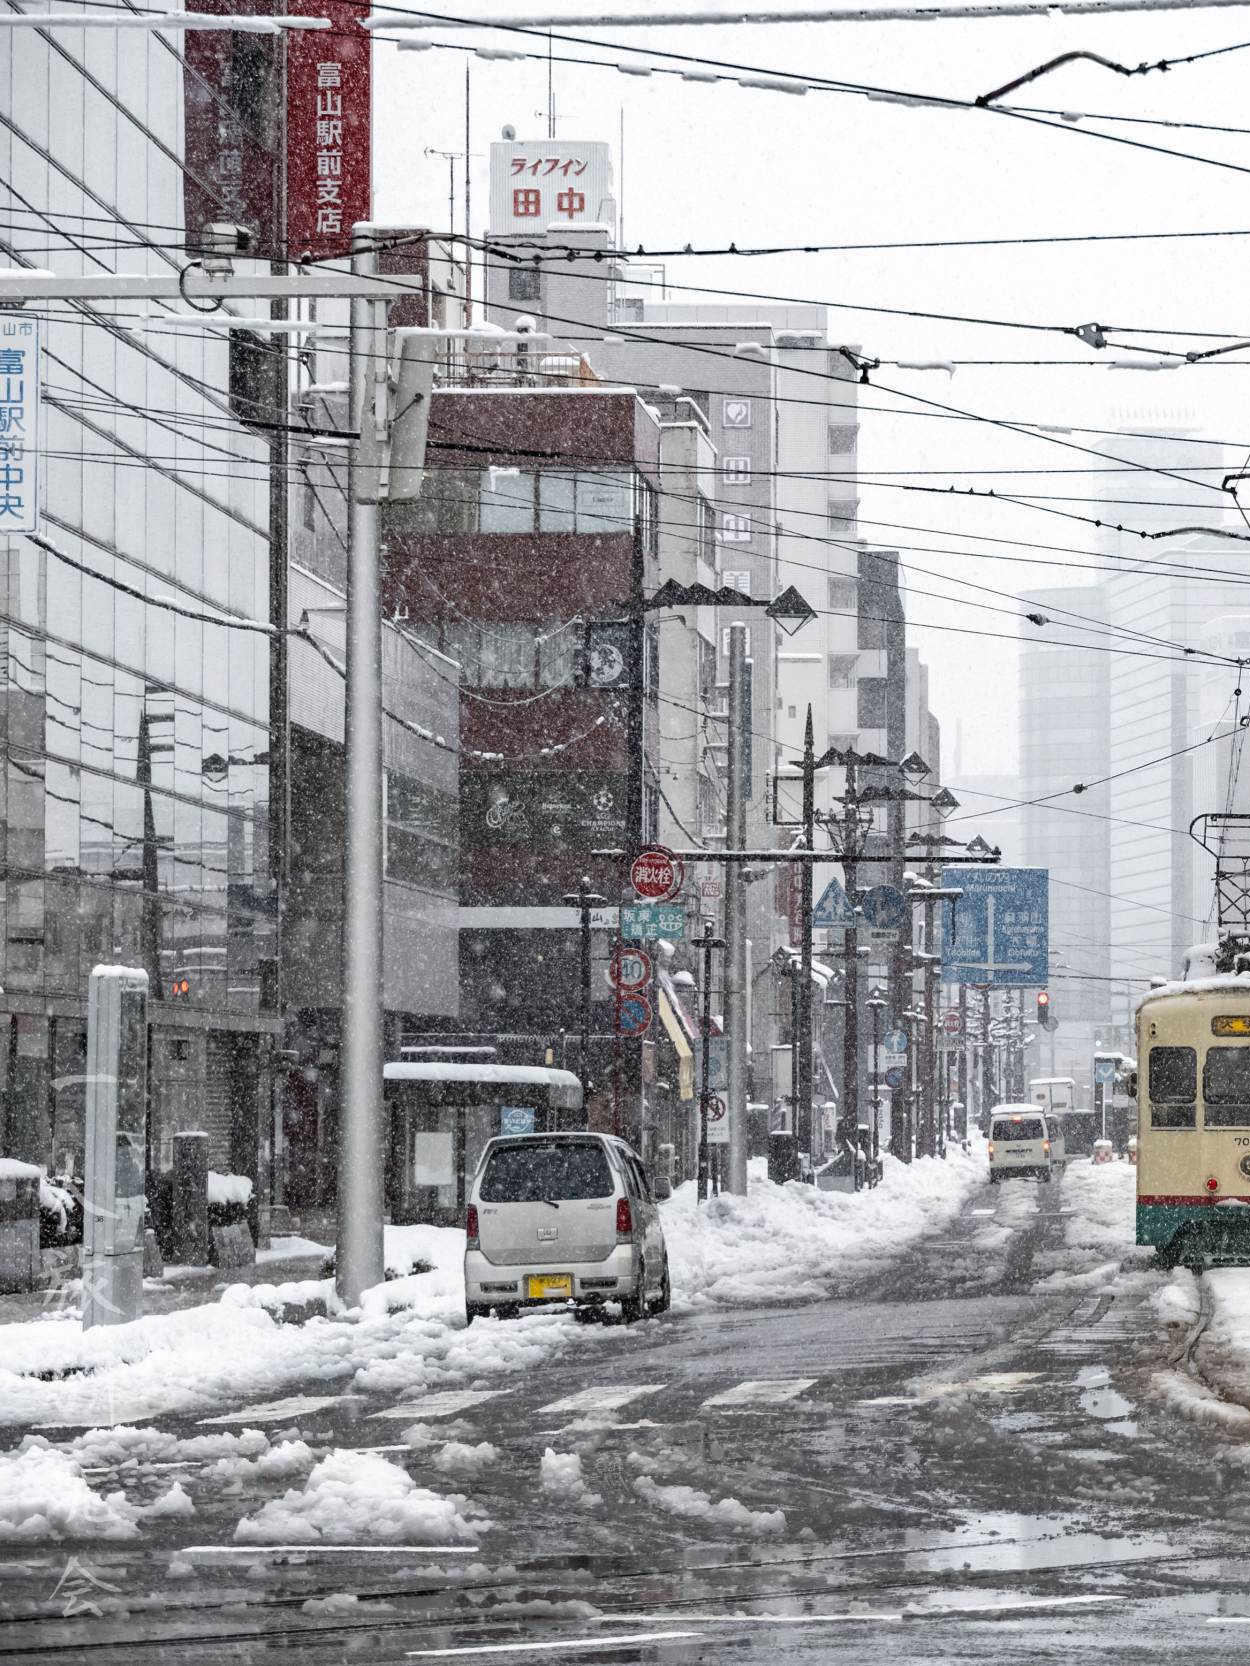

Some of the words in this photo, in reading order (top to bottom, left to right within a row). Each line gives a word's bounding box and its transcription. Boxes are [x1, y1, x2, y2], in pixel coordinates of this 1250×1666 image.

[316, 61, 343, 234] 富山駅前支店
[510, 158, 589, 177] ライフイン
[513, 187, 585, 219] 田中
[0, 348, 26, 520] 富山駅前中央
[635, 865, 672, 885] 消火栓
[623, 960, 643, 979] 40
